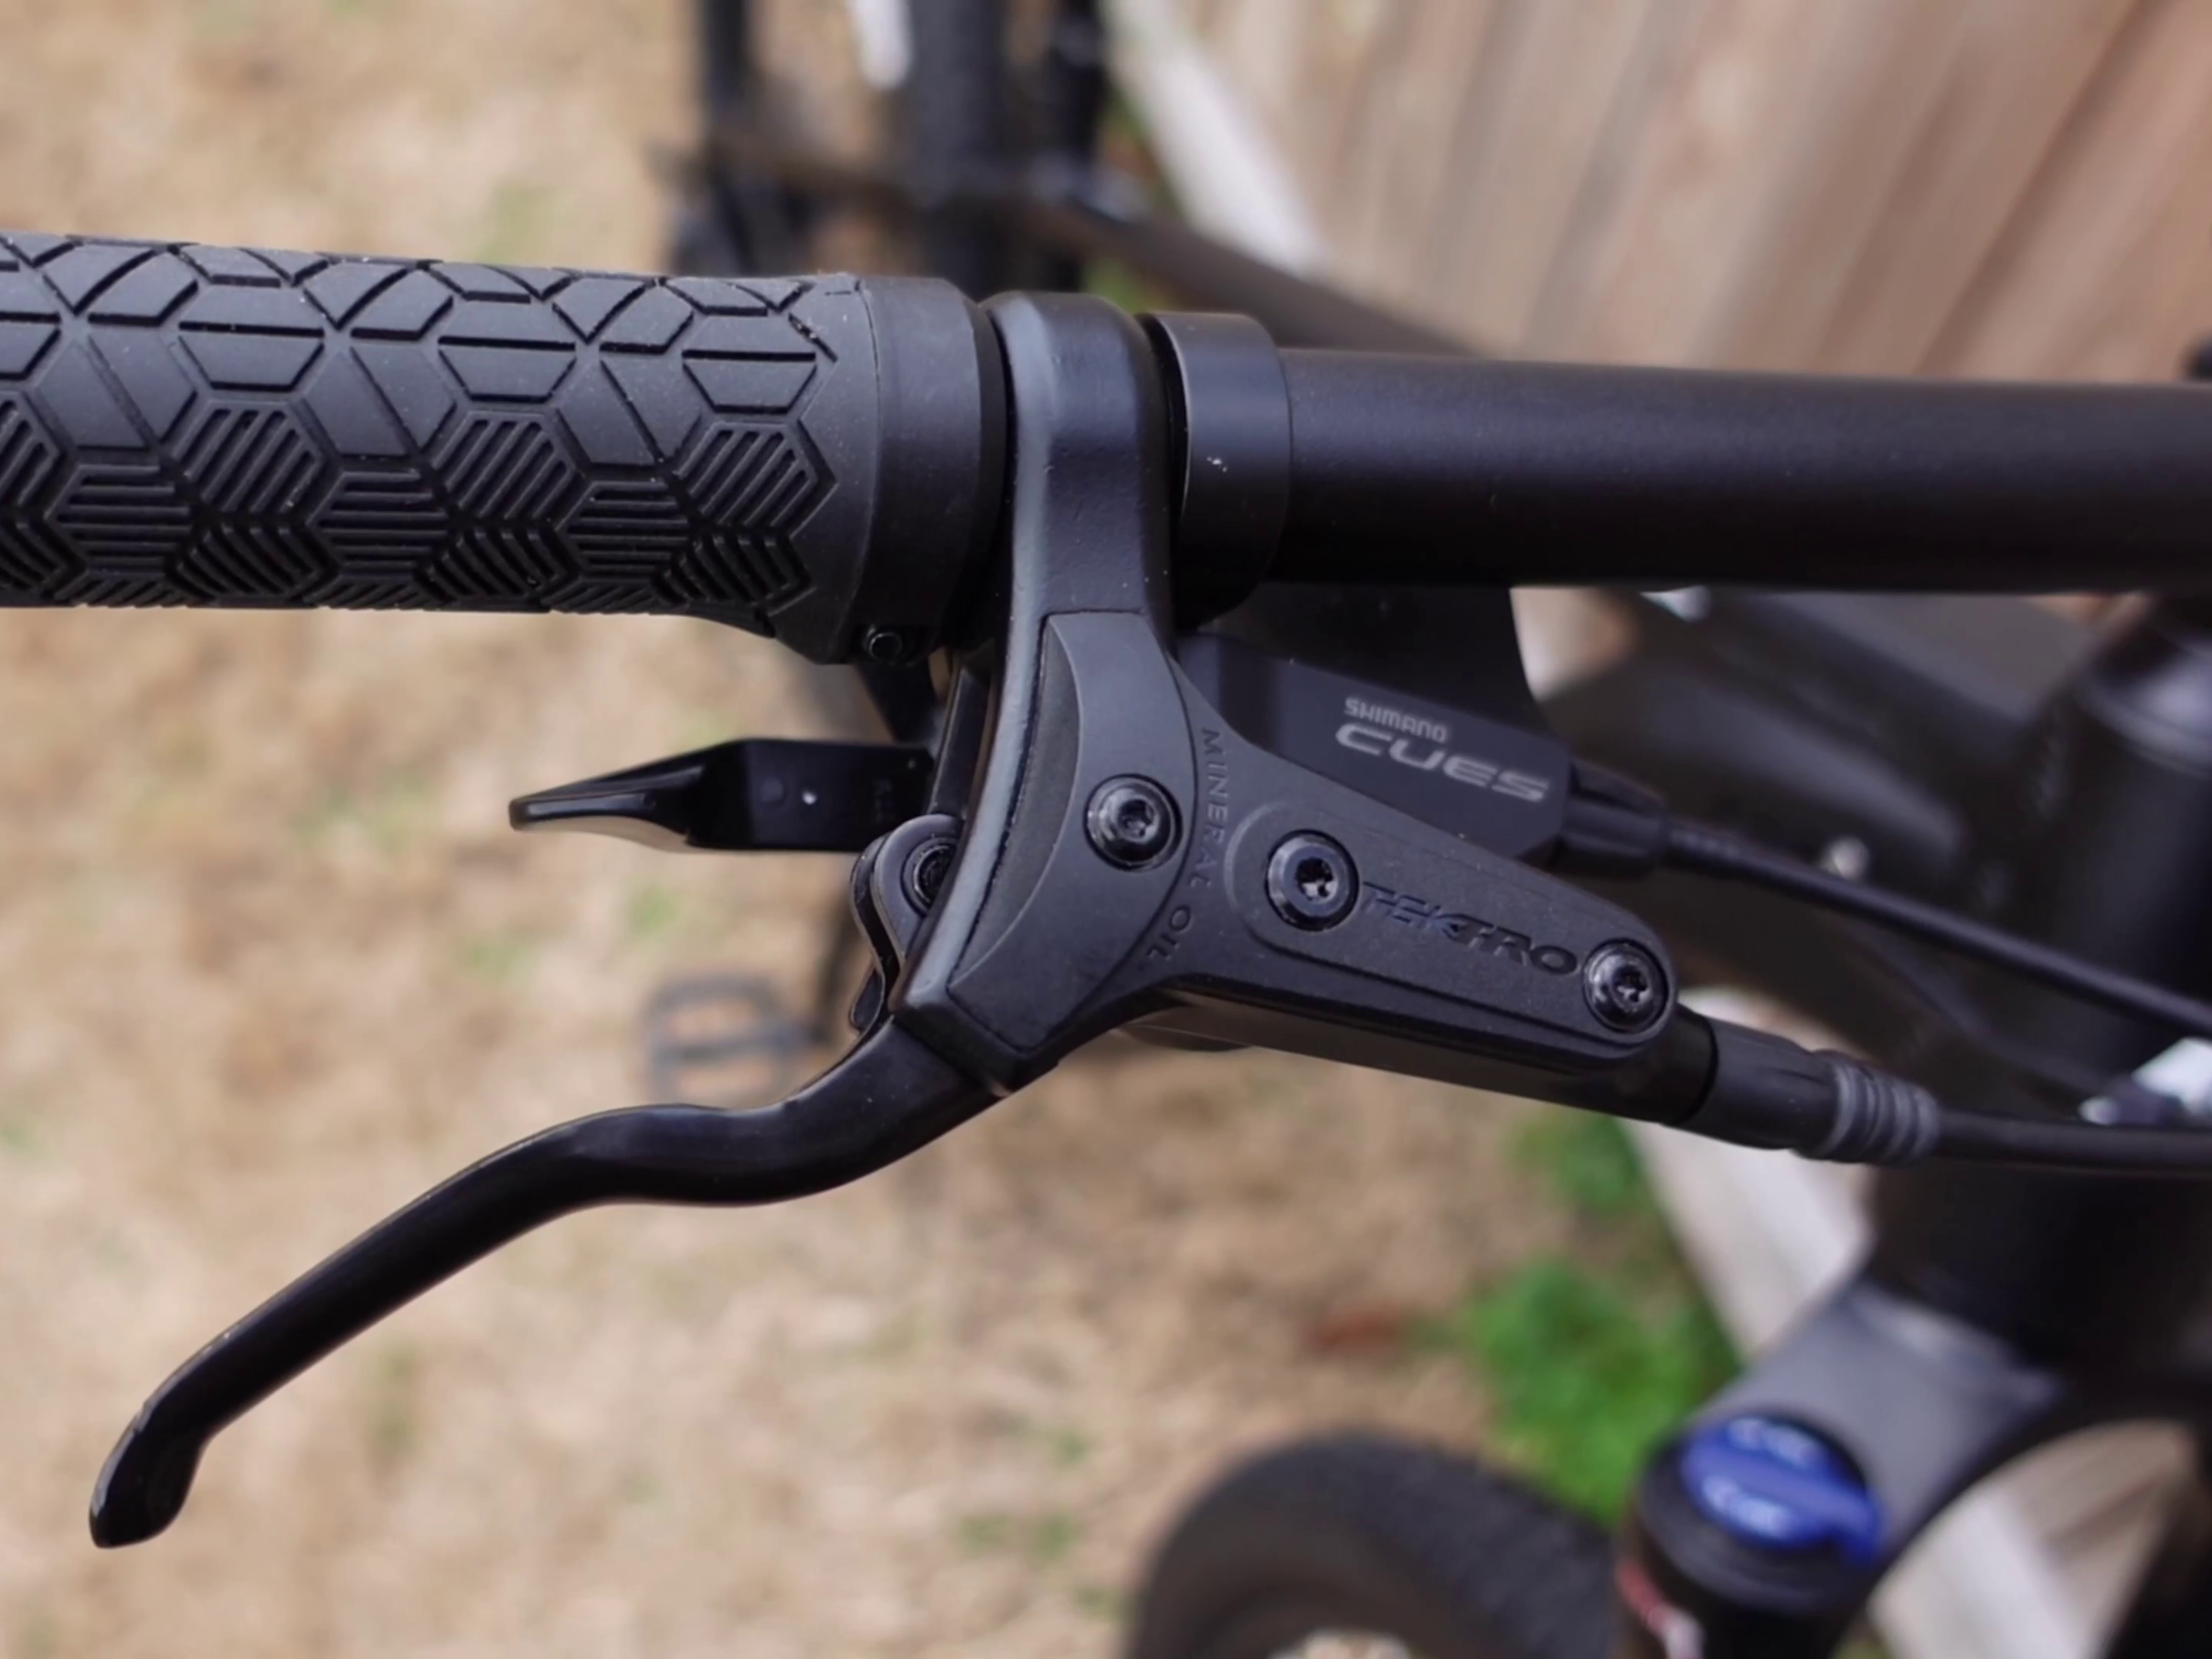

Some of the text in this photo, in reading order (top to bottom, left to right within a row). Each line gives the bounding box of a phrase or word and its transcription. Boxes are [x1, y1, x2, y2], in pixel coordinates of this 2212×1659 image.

[1336, 724, 1549, 803] CUES
[1344, 697, 1447, 743] SHIMANO
[1146, 727, 1229, 962] MINERAL OIL
[1362, 880, 1578, 975] TEKTRO
